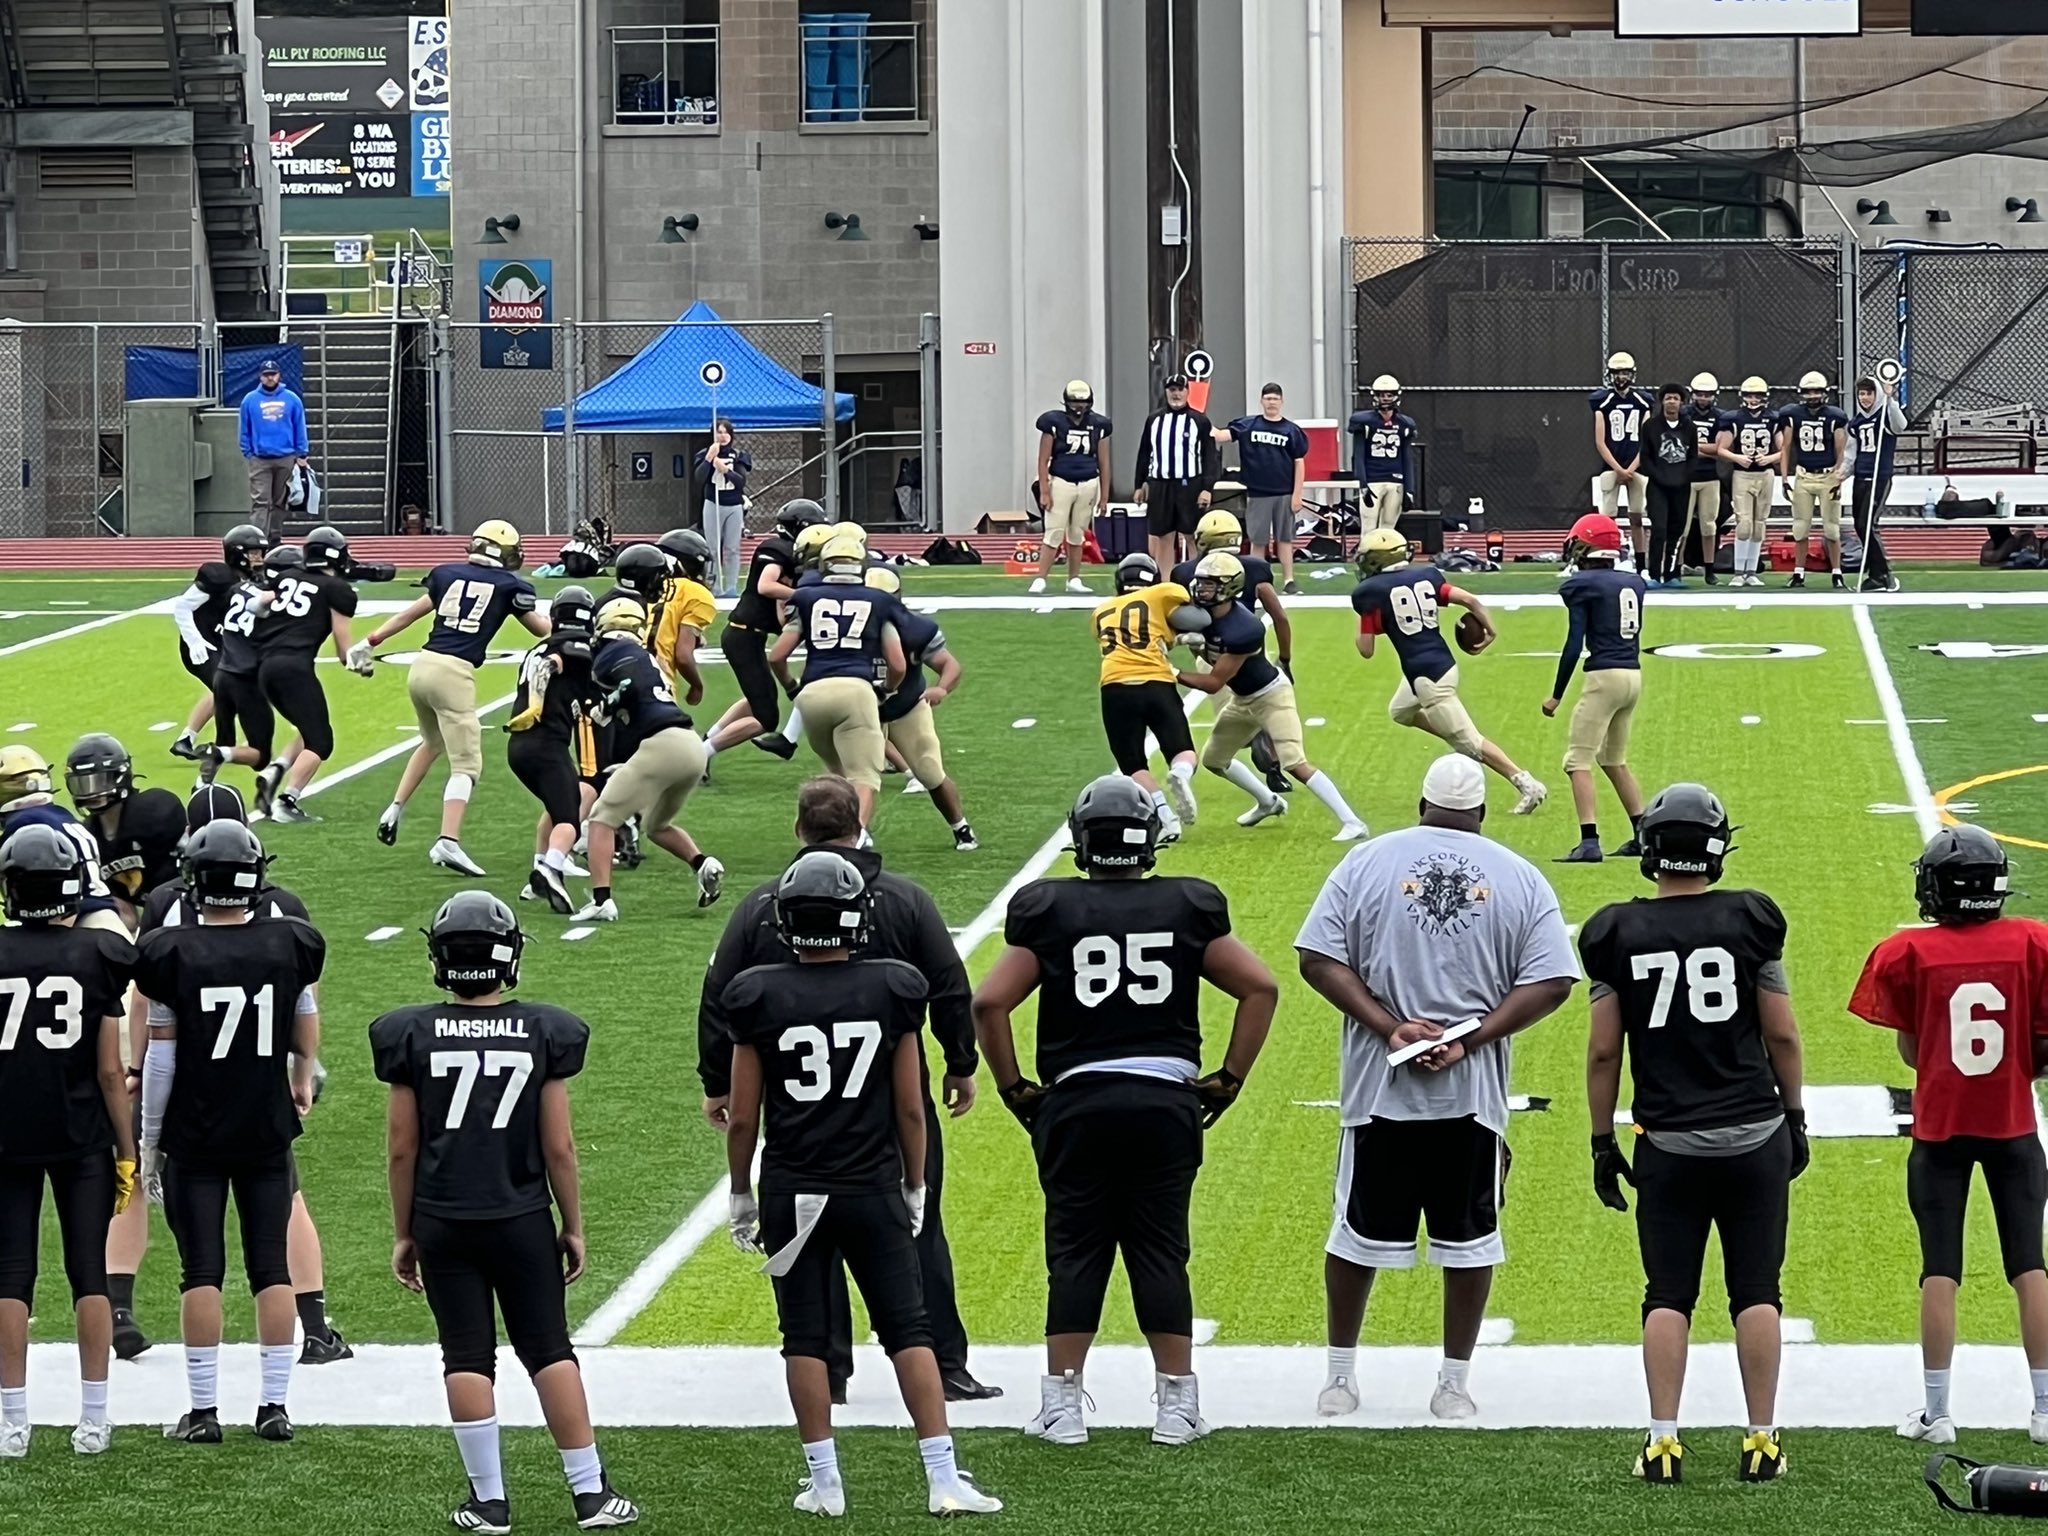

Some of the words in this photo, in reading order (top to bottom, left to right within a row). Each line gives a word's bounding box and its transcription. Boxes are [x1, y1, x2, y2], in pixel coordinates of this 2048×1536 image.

[268, 48, 289, 60] ALL
[291, 48, 310, 60] PLY
[313, 47, 365, 59] ROOFING
[368, 47, 386, 59] LLC
[283, 92, 306, 107] you
[307, 88, 349, 101] covered
[353, 124, 365, 138] 8
[368, 123, 393, 138] WA
[350, 141, 397, 154] LOCATIONS
[353, 156, 365, 169] TO
[367, 156, 396, 169] SERVE
[356, 171, 395, 188] YOU
[488, 306, 543, 319] DIAMOND
[1371, 433, 1401, 458] 23
[270, 578, 319, 617] 35
[438, 579, 495, 634] 47
[223, 593, 256, 637] 24
[810, 598, 872, 650] 67
[1093, 854, 1139, 866] Riddell
[1660, 858, 1708, 872] Riddell
[204, 895, 250, 907] Riddell
[20, 905, 66, 919] Riddell
[792, 935, 841, 948] Riddell
[447, 968, 497, 981] Riddell
[1072, 932, 1174, 1008] 85
[1630, 946, 1739, 1029] 78
[0, 976, 83, 1050] 73
[200, 983, 274, 1060] 71
[434, 1018, 530, 1038] MARSHALL
[1949, 981, 2006, 1076] 6
[777, 1020, 882, 1102] 37
[430, 1050, 534, 1130] 77
